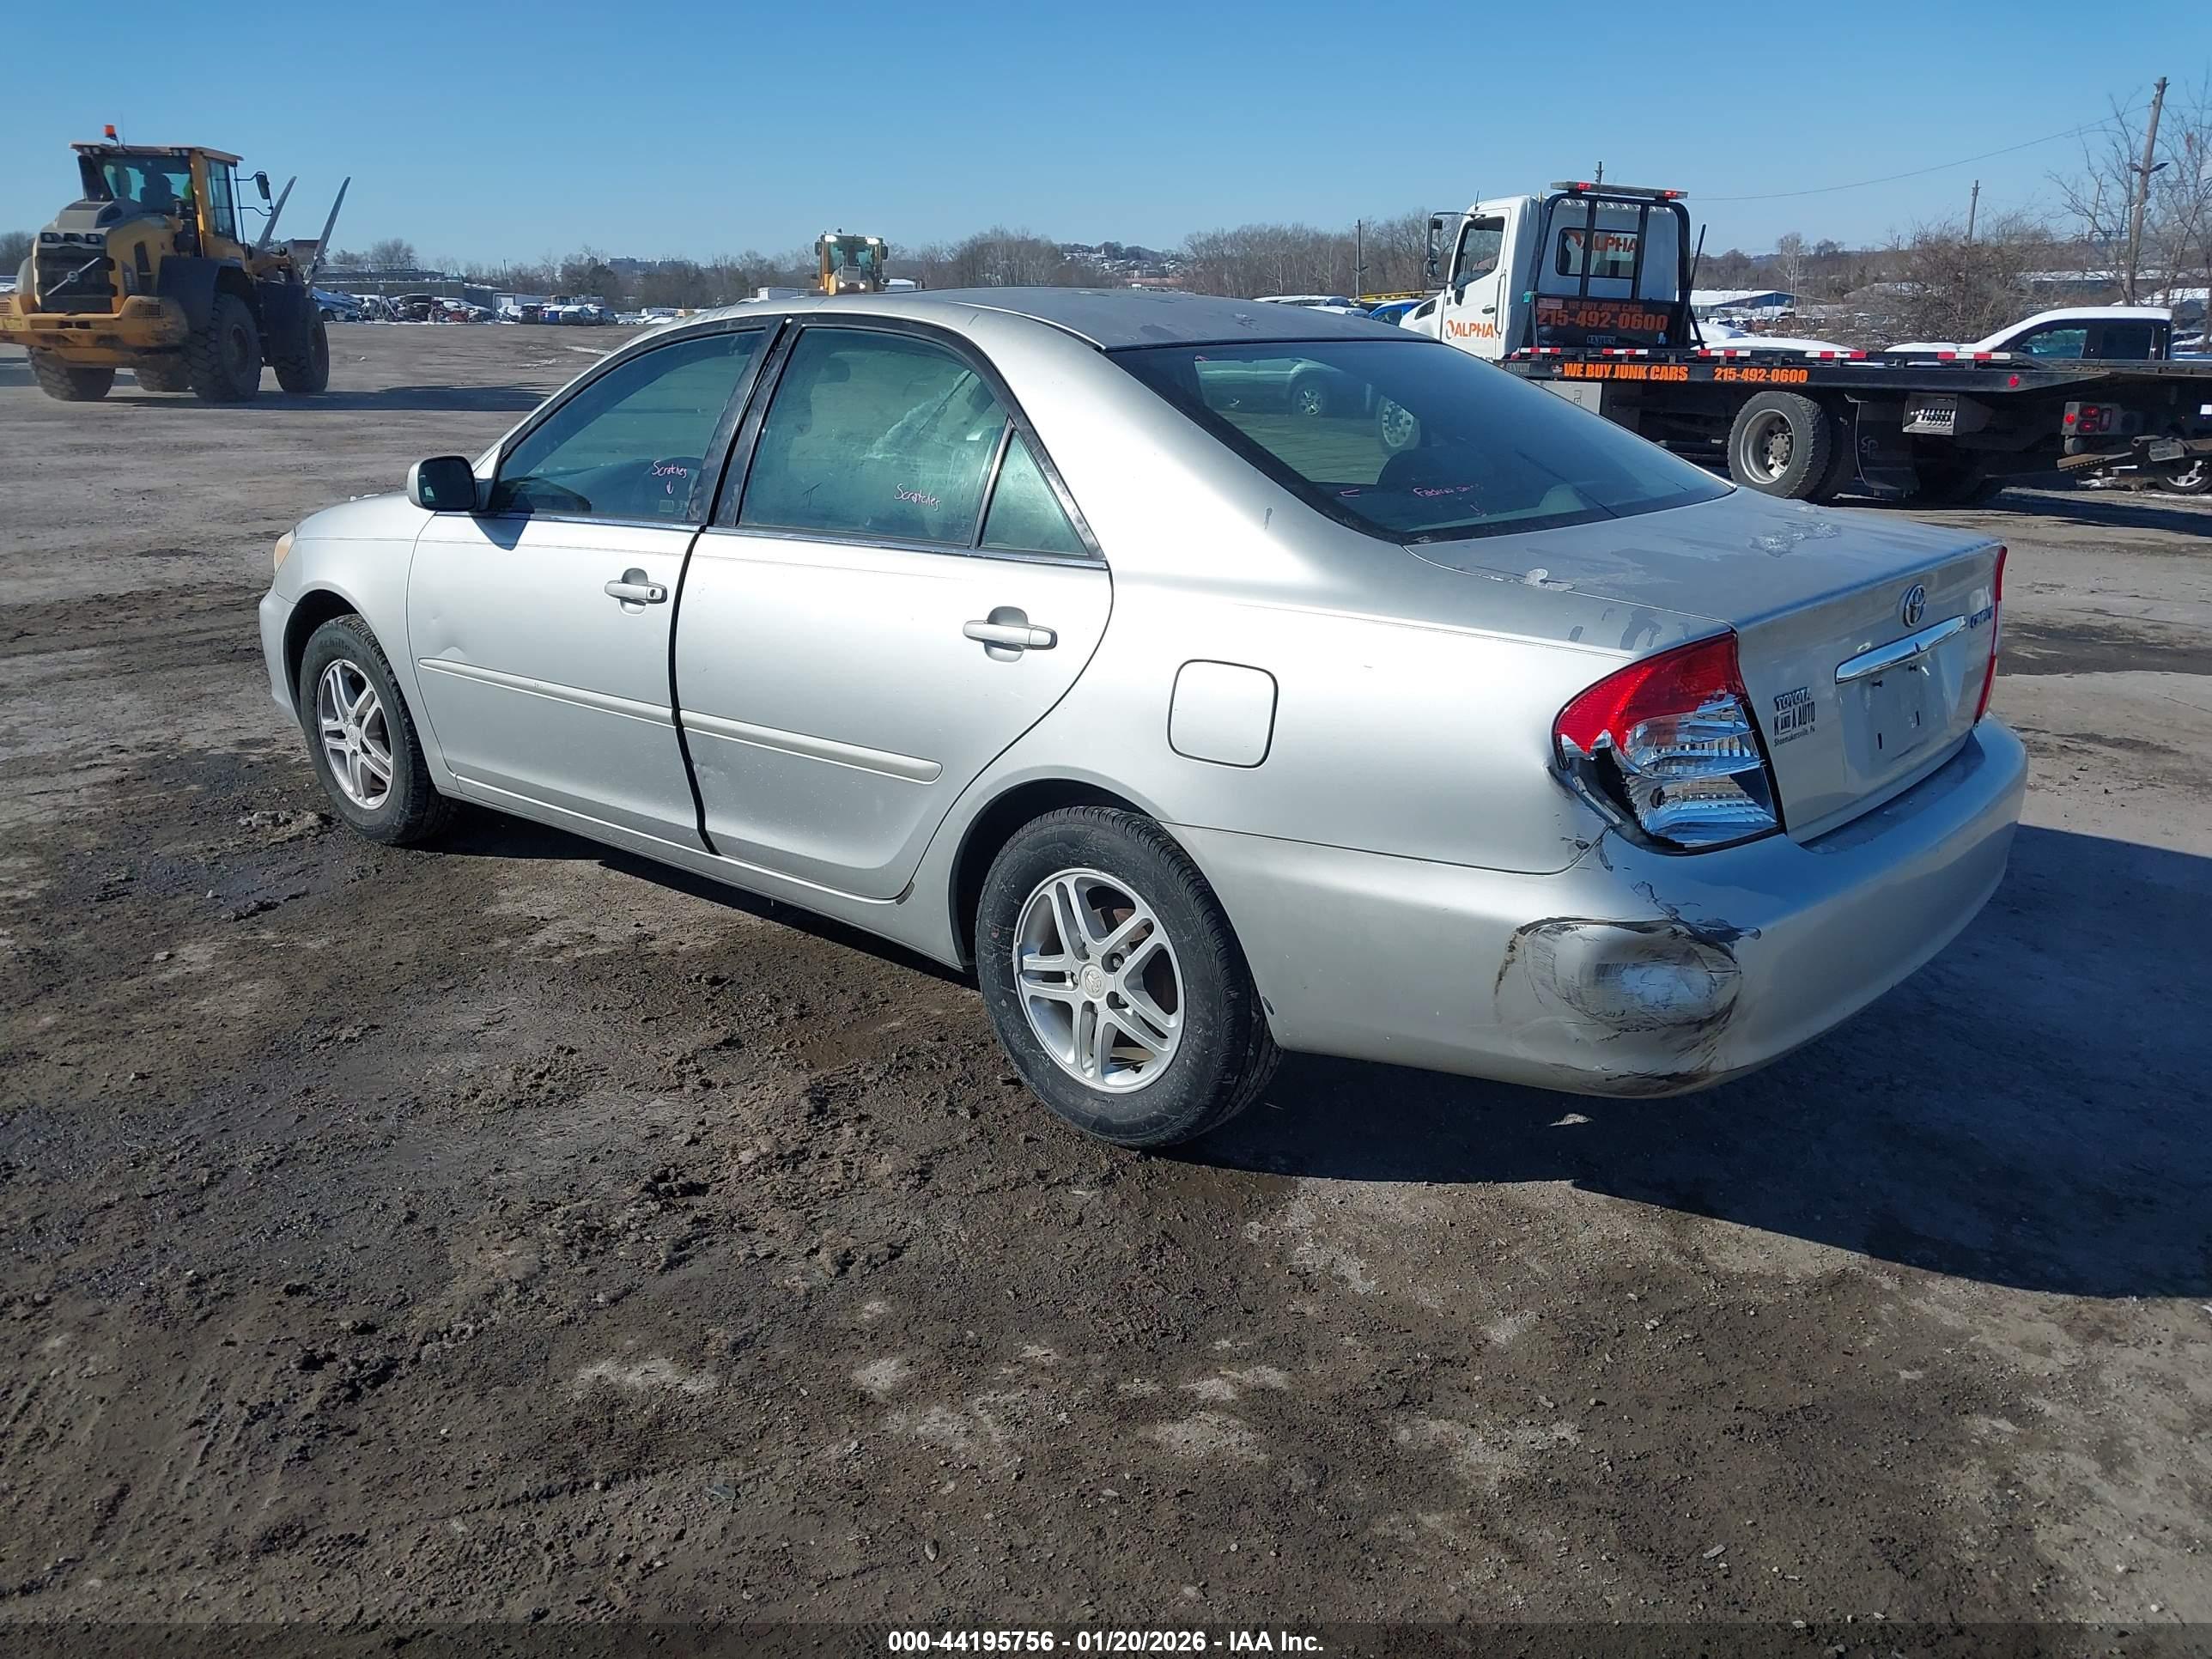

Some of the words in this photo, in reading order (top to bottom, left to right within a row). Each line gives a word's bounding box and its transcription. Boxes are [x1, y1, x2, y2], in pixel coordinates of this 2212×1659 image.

[1454, 322, 1495, 338] ALPHA
[1536, 309, 1668, 331] 215-492-0600
[1564, 362, 1585, 378] WE
[1585, 363, 1613, 379] BUY
[1614, 364, 1649, 380] JUNK
[1650, 365, 1689, 382] CARS
[1713, 367, 1808, 383] 215-492-0600
[1773, 687, 1813, 712] TOYOTA
[1773, 714, 1779, 736] K
[1798, 701, 1816, 728] AUTO
